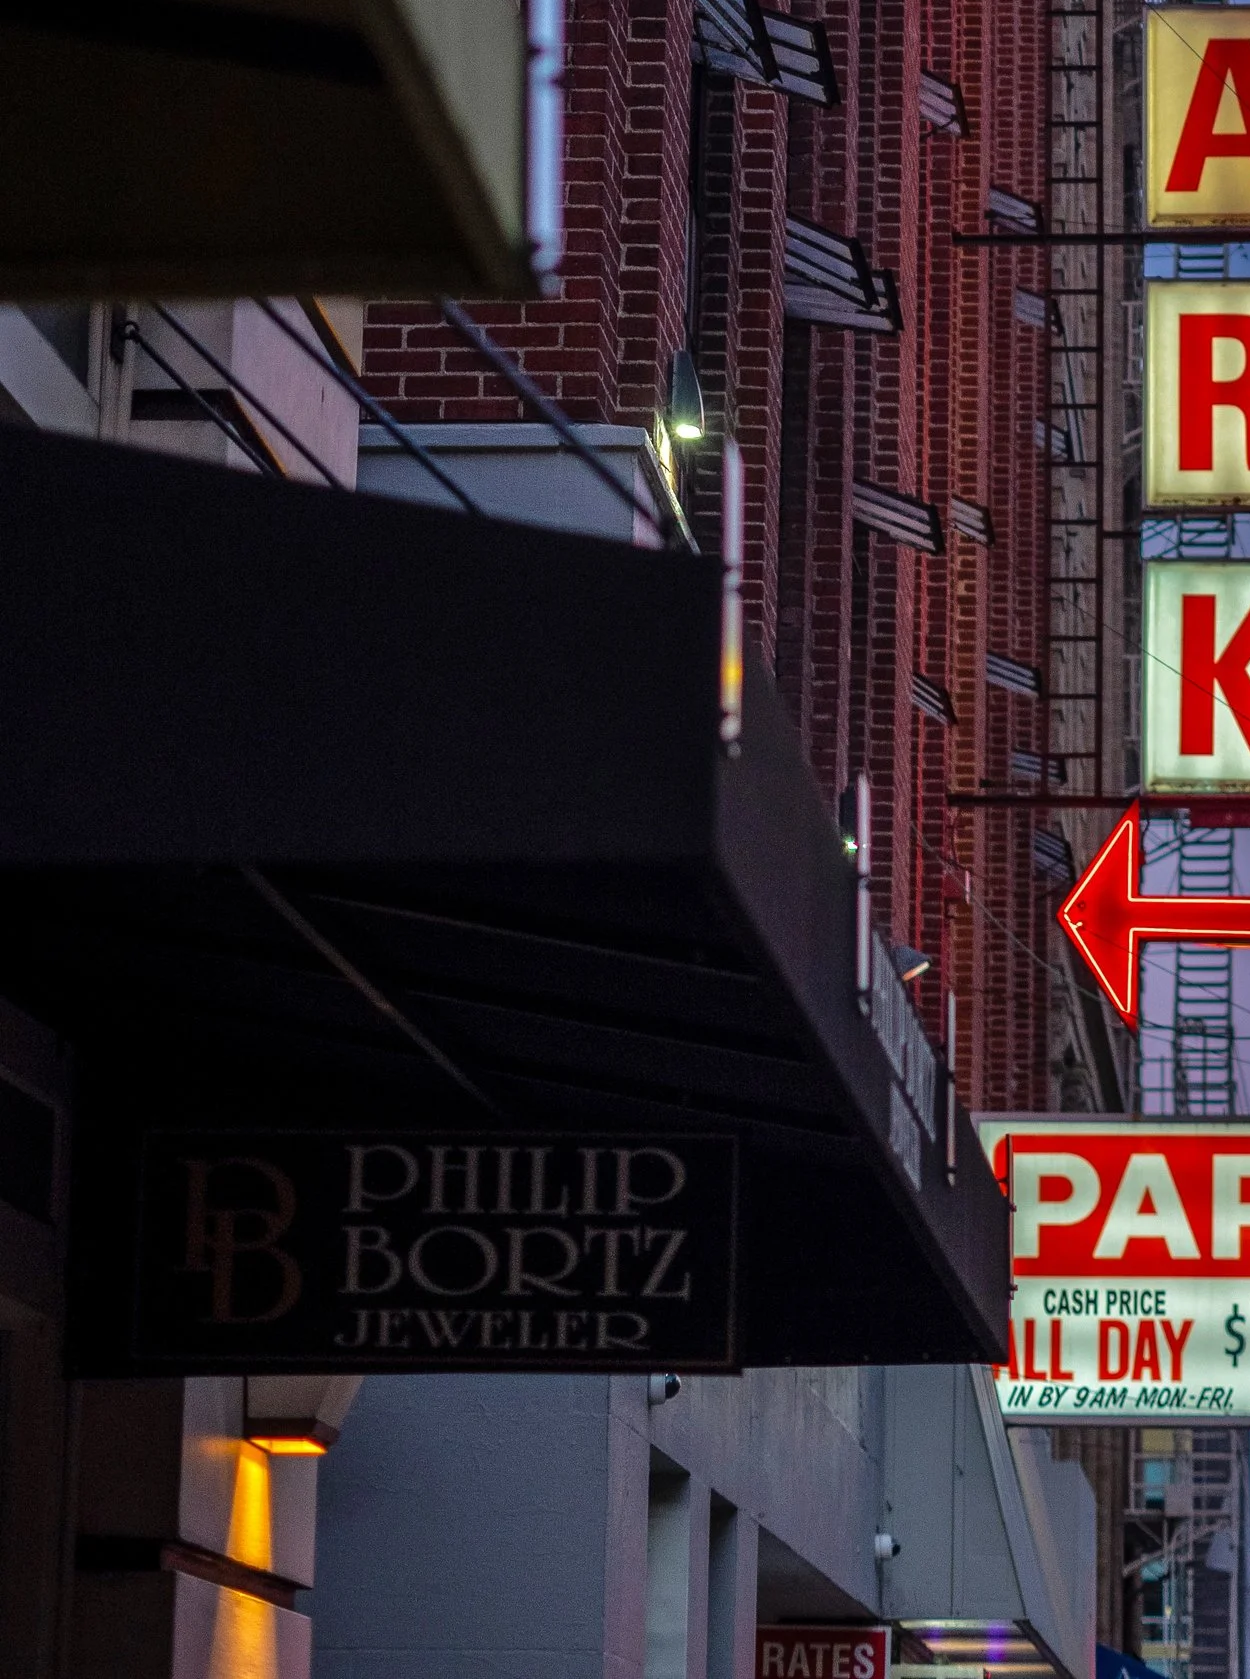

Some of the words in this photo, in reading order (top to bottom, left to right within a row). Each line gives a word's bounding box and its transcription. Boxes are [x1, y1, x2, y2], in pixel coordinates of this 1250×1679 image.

[340, 1143, 687, 1218] PHILIP
[336, 1223, 691, 1303] BORTZ
[1044, 1288, 1098, 1315] CASH
[1106, 1289, 1167, 1316] PRICE
[333, 1309, 651, 1351] JEWELER
[1098, 1318, 1194, 1382] DAY
[1008, 1386, 1034, 1408] IN
[1038, 1386, 1068, 1408] BY
[761, 1641, 875, 1679] RATES
